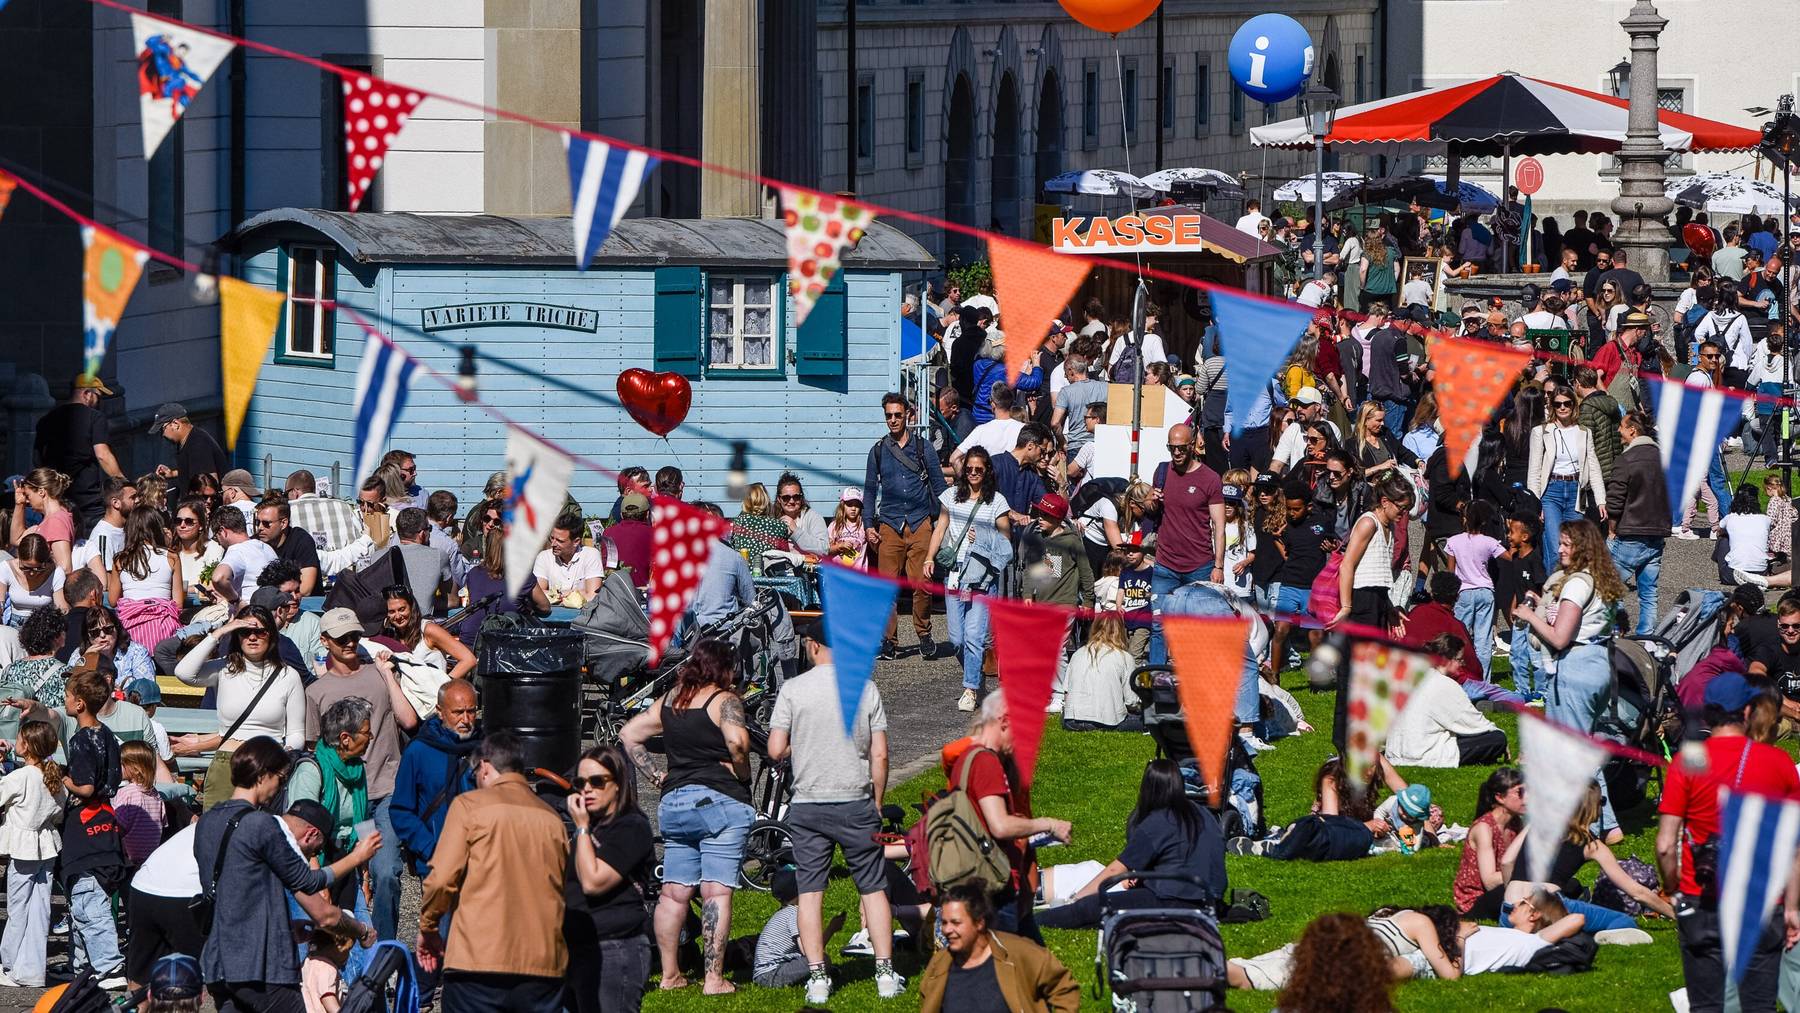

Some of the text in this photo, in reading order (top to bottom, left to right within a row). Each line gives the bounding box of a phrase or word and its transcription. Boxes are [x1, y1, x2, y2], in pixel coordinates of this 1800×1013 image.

[1052, 215, 1202, 249] KASSE
[1135, 579, 1152, 592] ARE
[1126, 589, 1144, 598] ONE
